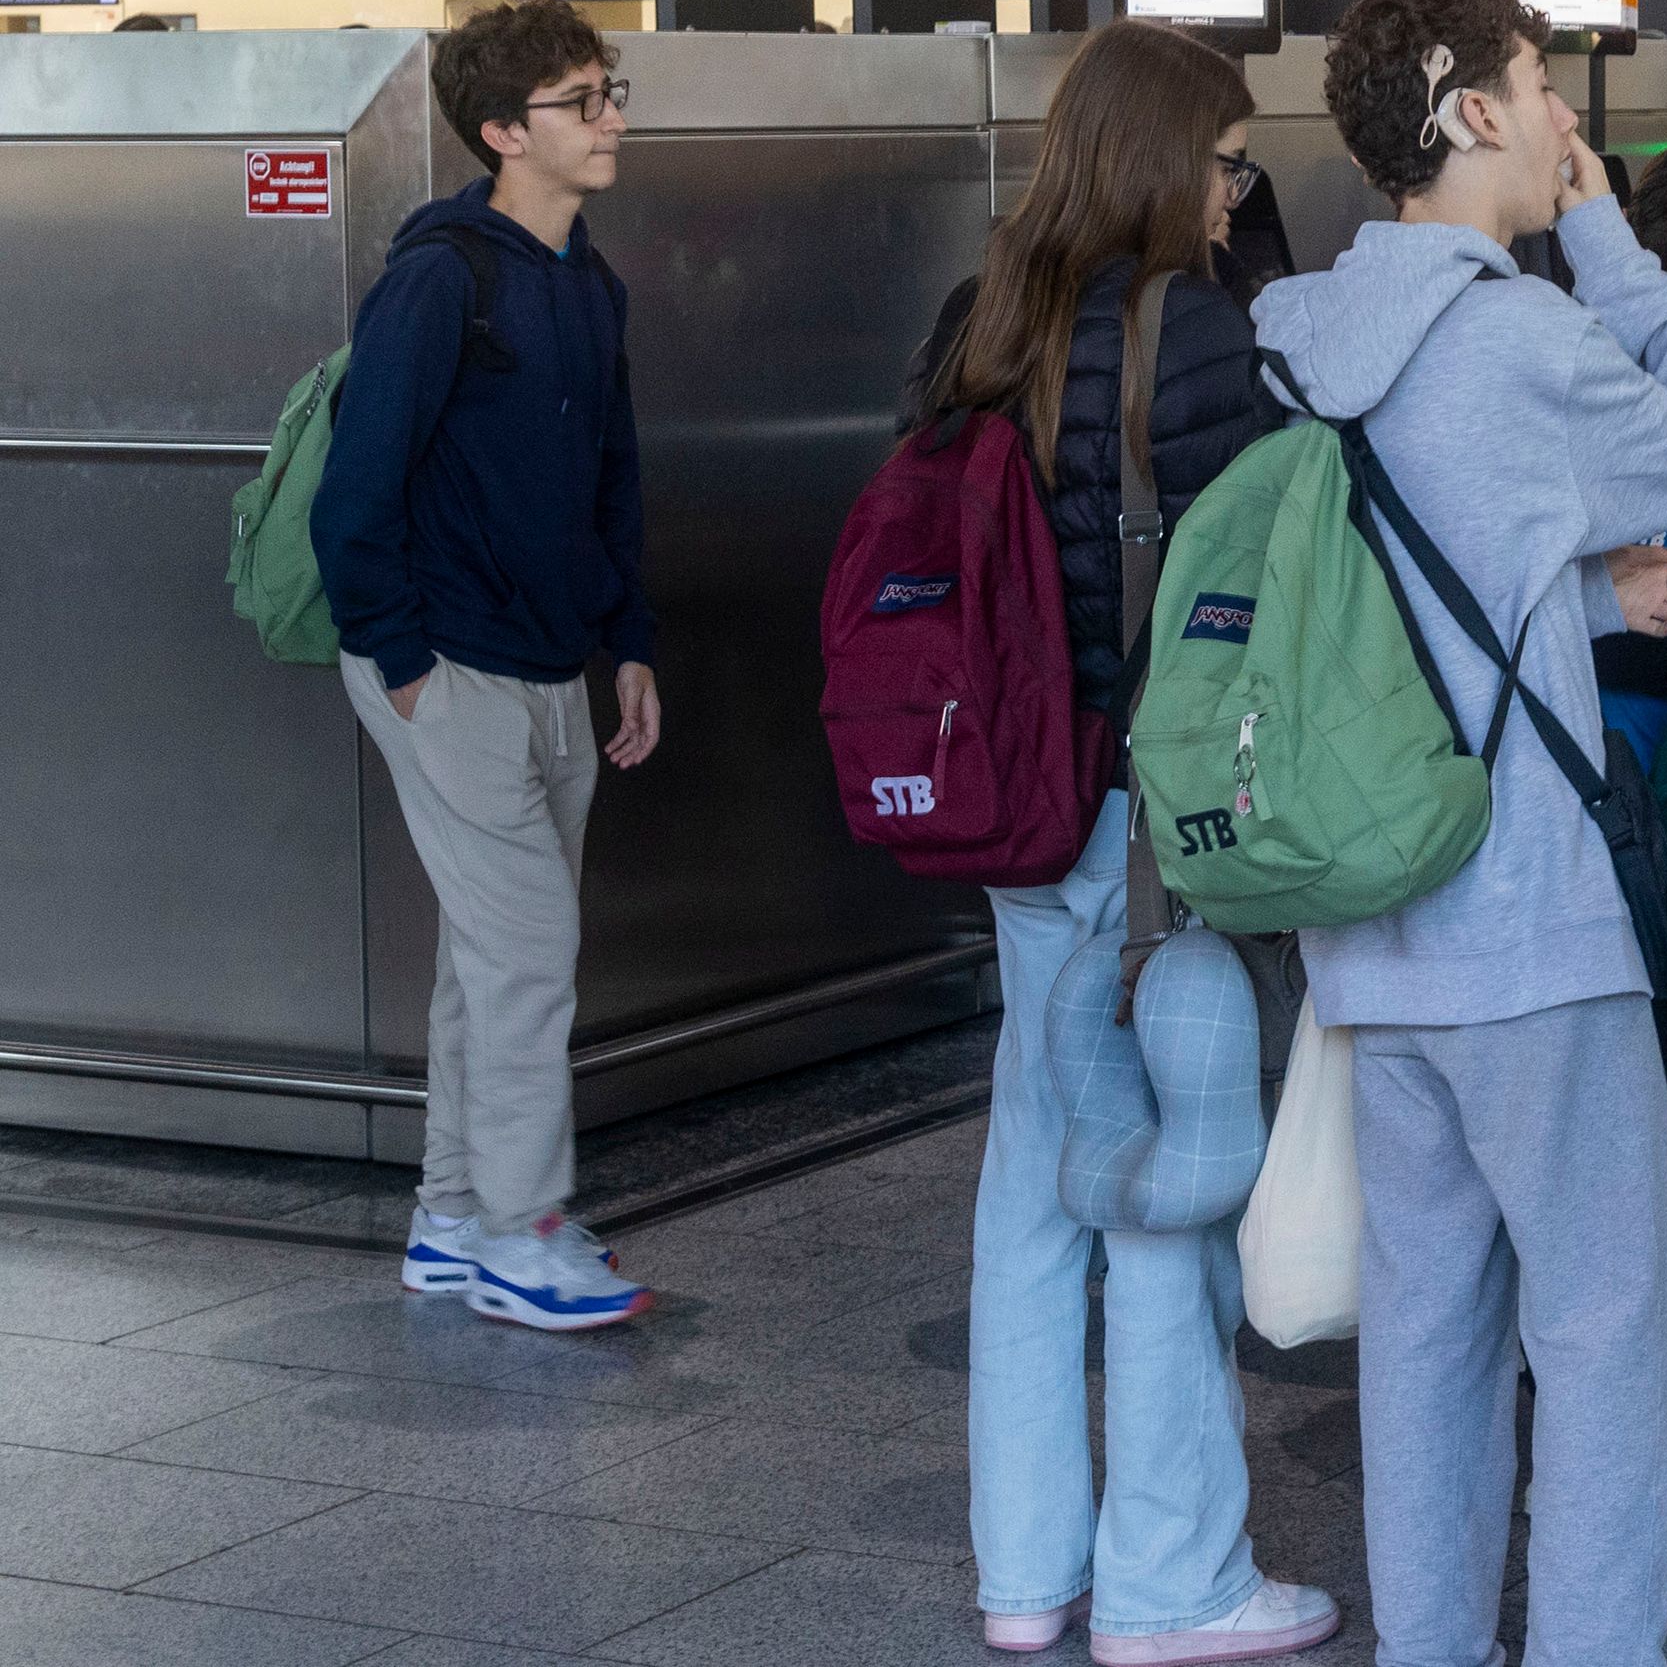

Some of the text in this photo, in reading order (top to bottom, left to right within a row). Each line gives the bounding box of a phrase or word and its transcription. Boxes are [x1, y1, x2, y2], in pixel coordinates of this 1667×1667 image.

[1191, 605, 1255, 630] JANSPO
[871, 774, 936, 817] STB
[1175, 807, 1238, 857] STB
